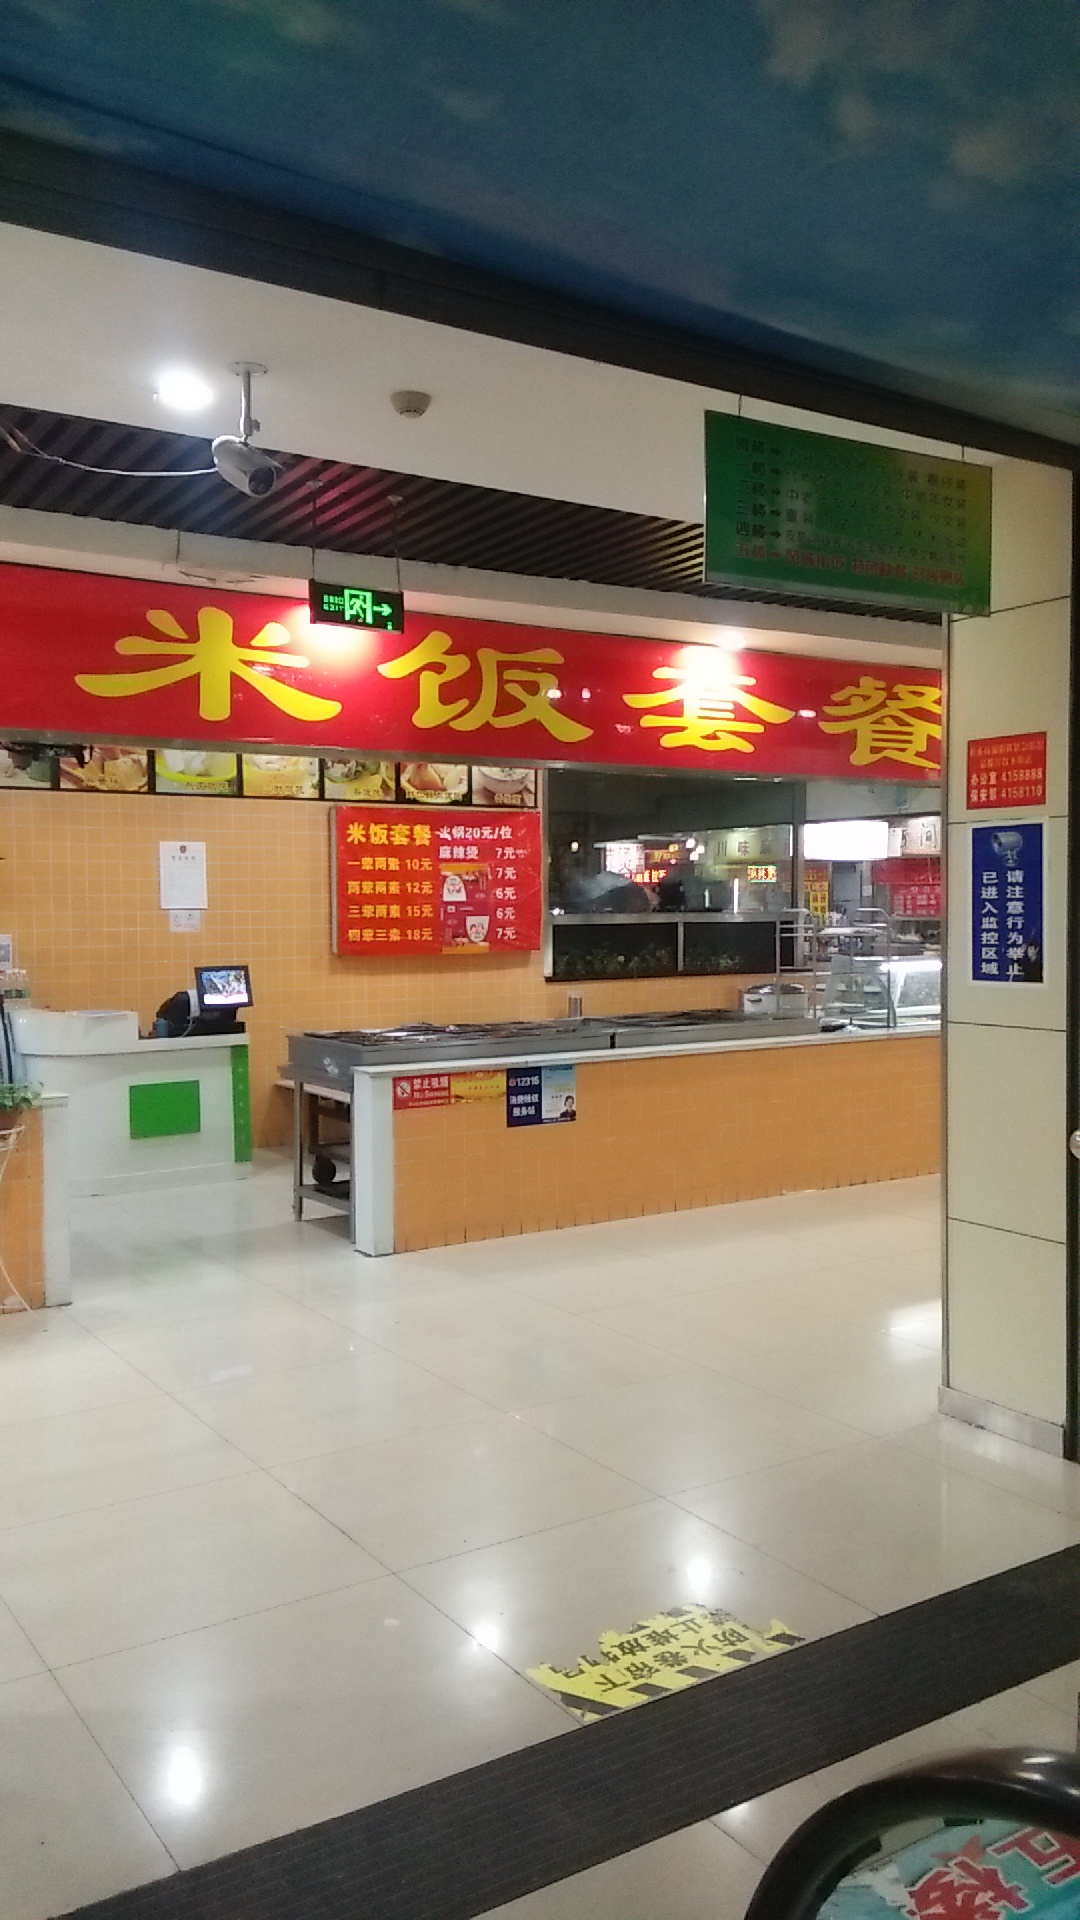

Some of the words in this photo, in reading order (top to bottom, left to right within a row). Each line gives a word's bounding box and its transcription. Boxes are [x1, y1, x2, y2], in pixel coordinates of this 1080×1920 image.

[75, 606, 942, 770] 米饭套餐
[346, 822, 432, 846] 米饭套餐
[439, 846, 479, 859] 麻辣烫
[495, 847, 516, 860] 7元
[405, 857, 433, 871] 10元
[495, 867, 517, 880] 7元
[405, 881, 433, 895] 12元
[495, 887, 517, 900] 6元
[406, 904, 434, 918] 15元
[496, 907, 516, 920] 6元
[980, 871, 999, 976] 已进入监控区域
[1005, 869, 1025, 976] 请注意行为举止
[406, 927, 433, 941] 18元
[496, 927, 517, 941] 7元
